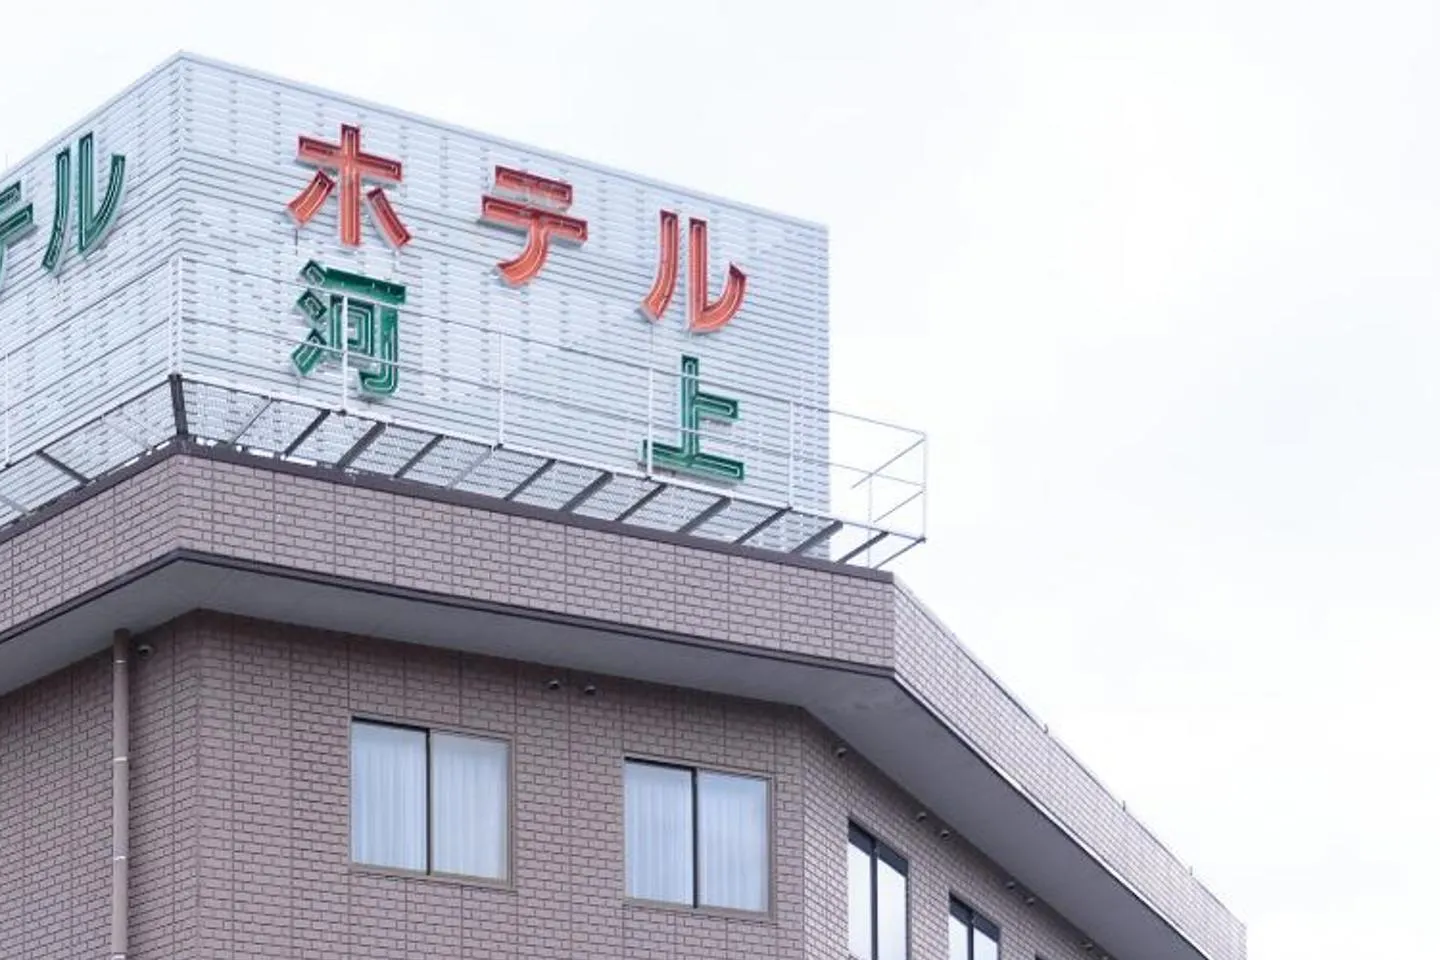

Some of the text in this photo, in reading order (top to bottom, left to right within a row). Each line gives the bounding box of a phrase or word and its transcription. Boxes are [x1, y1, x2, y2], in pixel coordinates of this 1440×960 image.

[287, 123, 746, 332] ホテル
[291, 259, 745, 481] 河上
